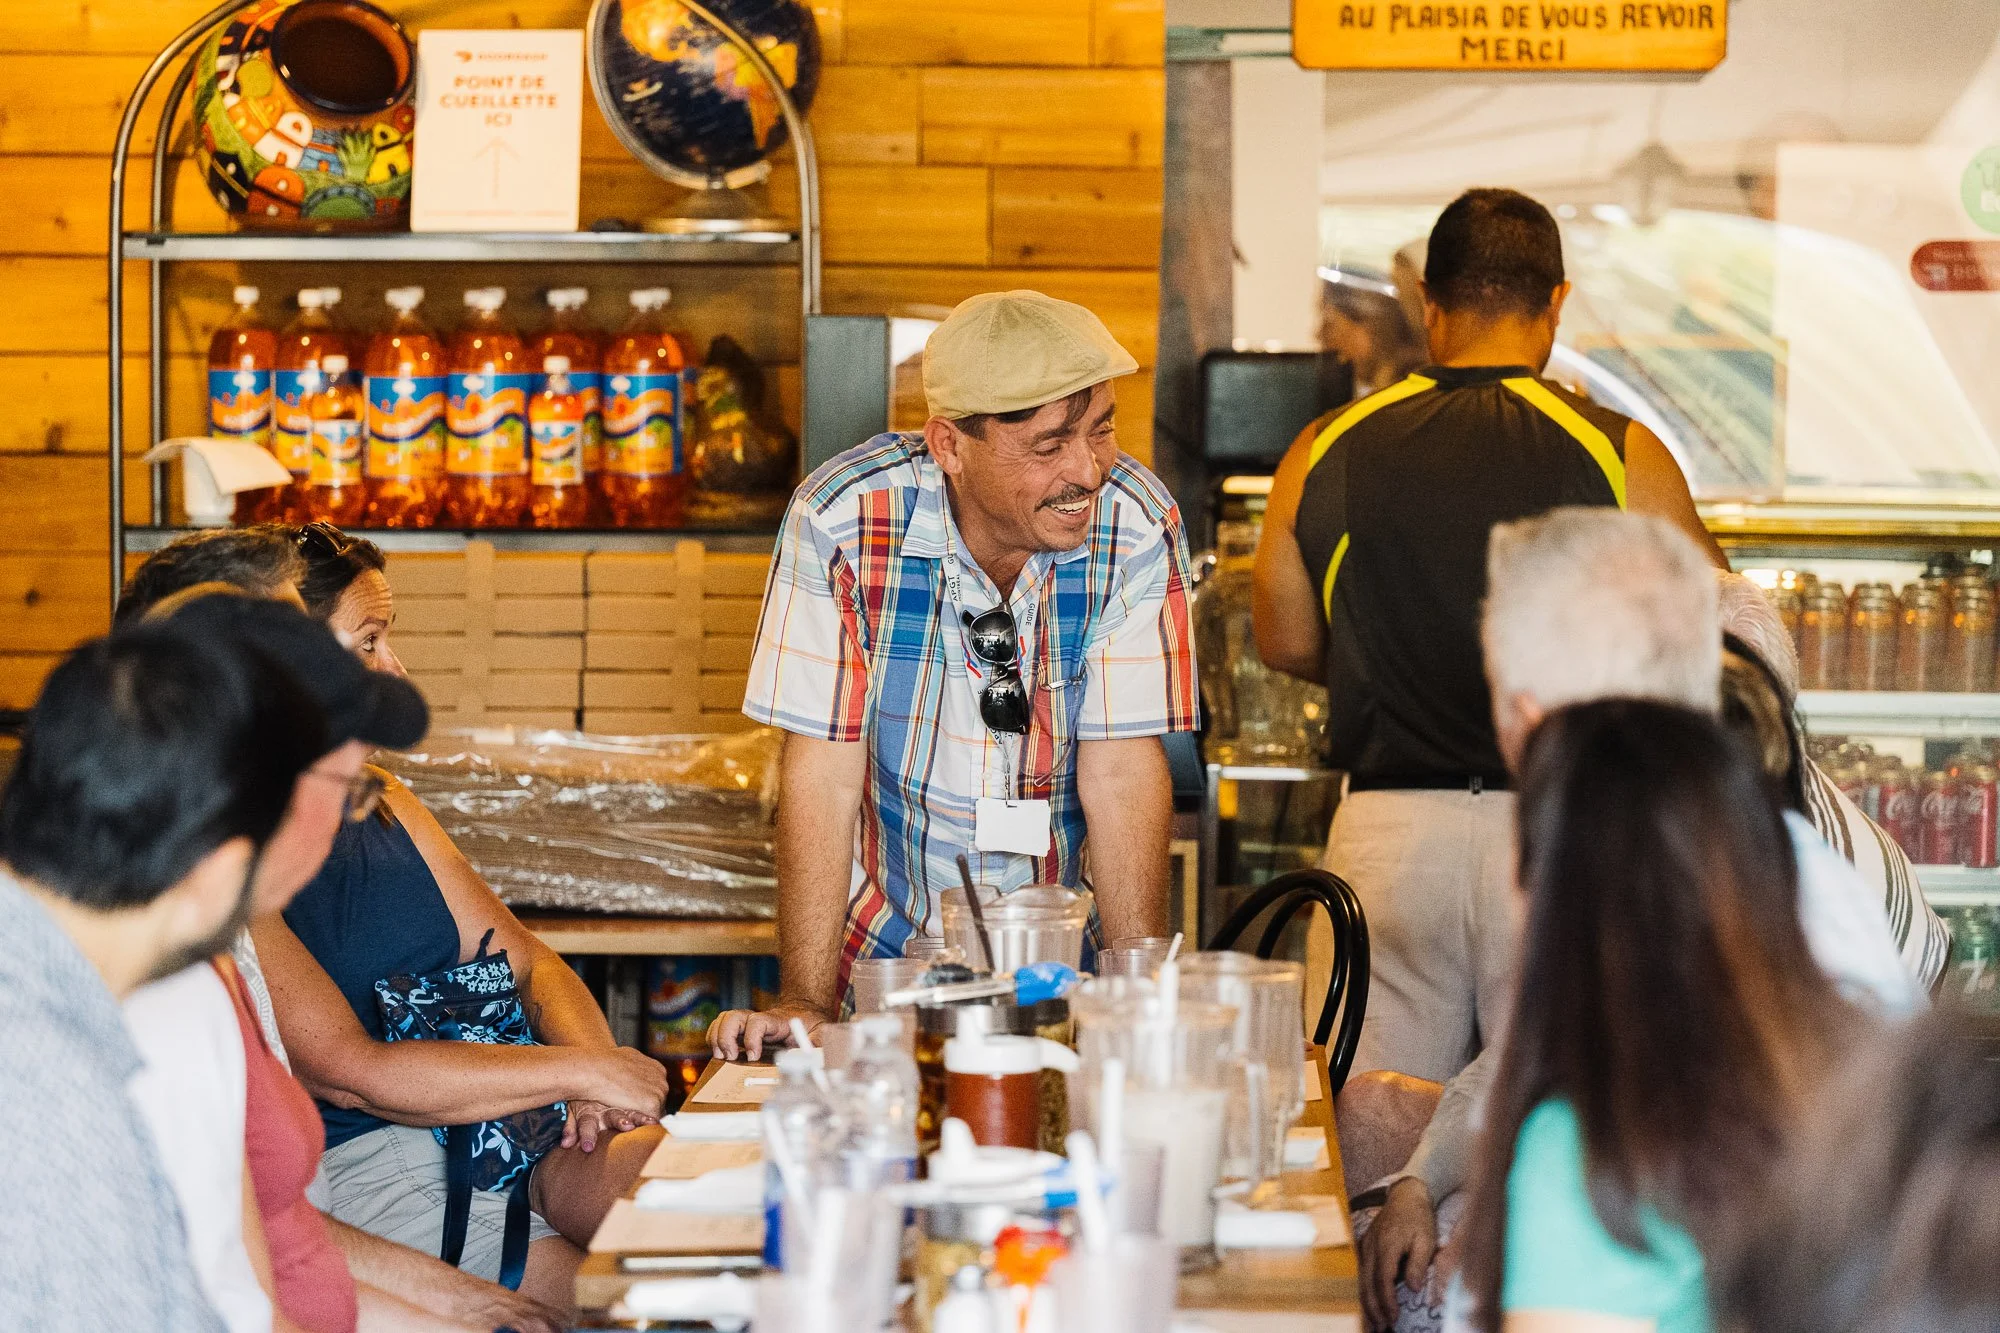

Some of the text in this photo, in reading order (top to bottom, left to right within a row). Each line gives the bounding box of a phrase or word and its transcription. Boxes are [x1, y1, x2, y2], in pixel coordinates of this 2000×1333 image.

[1339, 5, 1375, 29] AU
[1389, 4, 1488, 33] PLAISIR
[1502, 6, 1529, 29] DE
[1621, 4, 1714, 29] REVOIR
[1460, 36, 1566, 62] MERCI
[453, 76, 545, 89] POINT DE
[438, 93, 558, 109] CUEILLETTE
[484, 113, 513, 127] ICI
[947, 575, 958, 602] APGT
[1025, 602, 1036, 626] GUIDE
